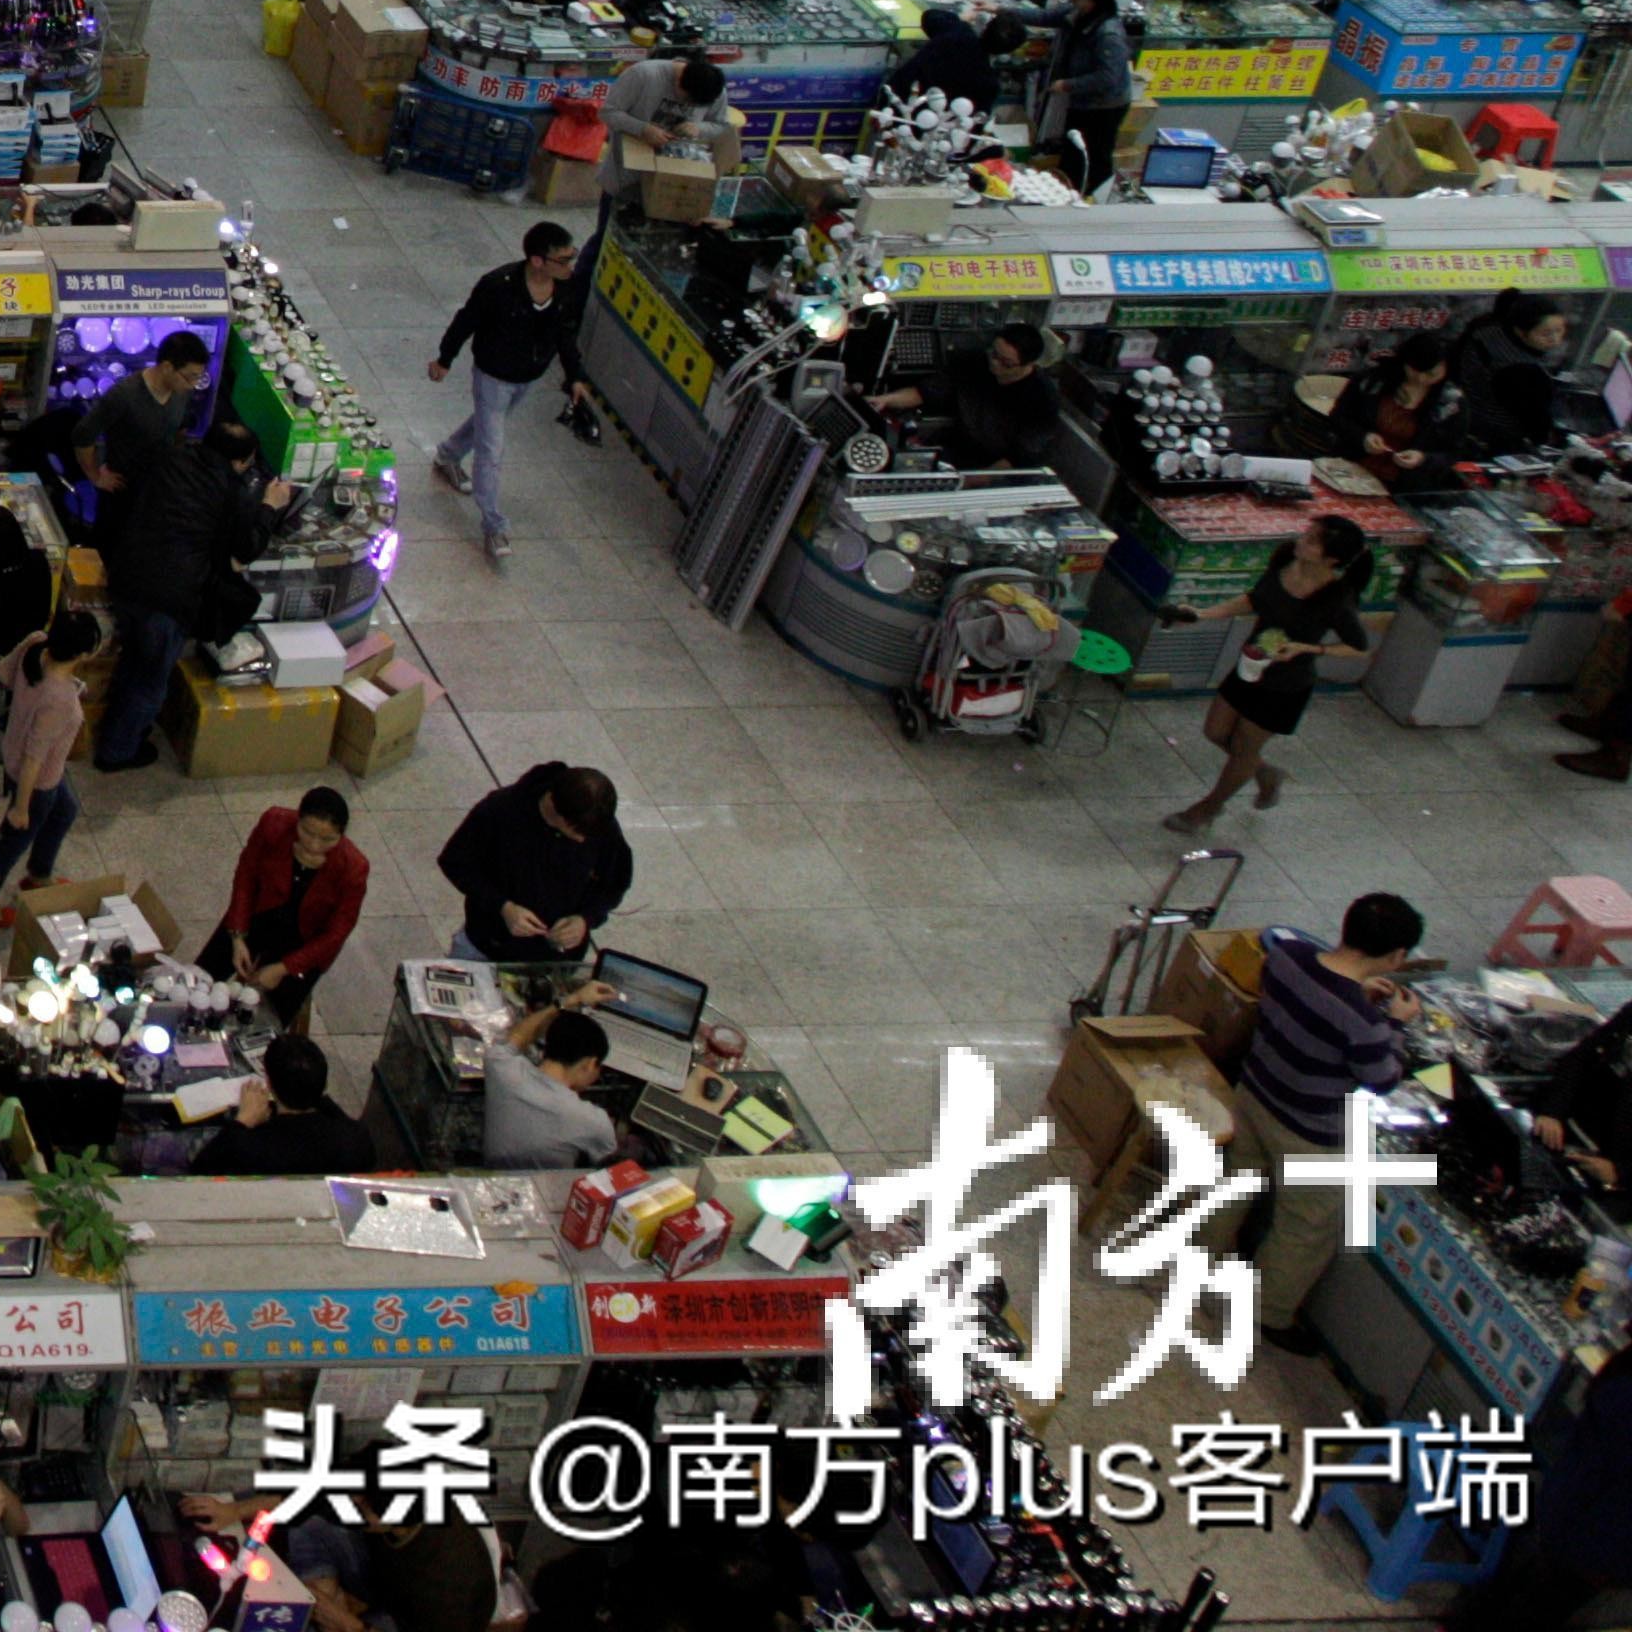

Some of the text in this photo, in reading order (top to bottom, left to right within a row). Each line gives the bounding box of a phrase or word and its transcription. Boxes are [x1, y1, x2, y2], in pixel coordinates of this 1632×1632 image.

[1336, 16, 1390, 76] 晶振
[478, 74, 525, 102] 防雨
[928, 258, 1039, 279] 仁和电子科技
[66, 273, 125, 292] 劲光集团
[131, 282, 226, 300] Sharp-rays Group
[182, 1294, 531, 1337] 振业电子公司
